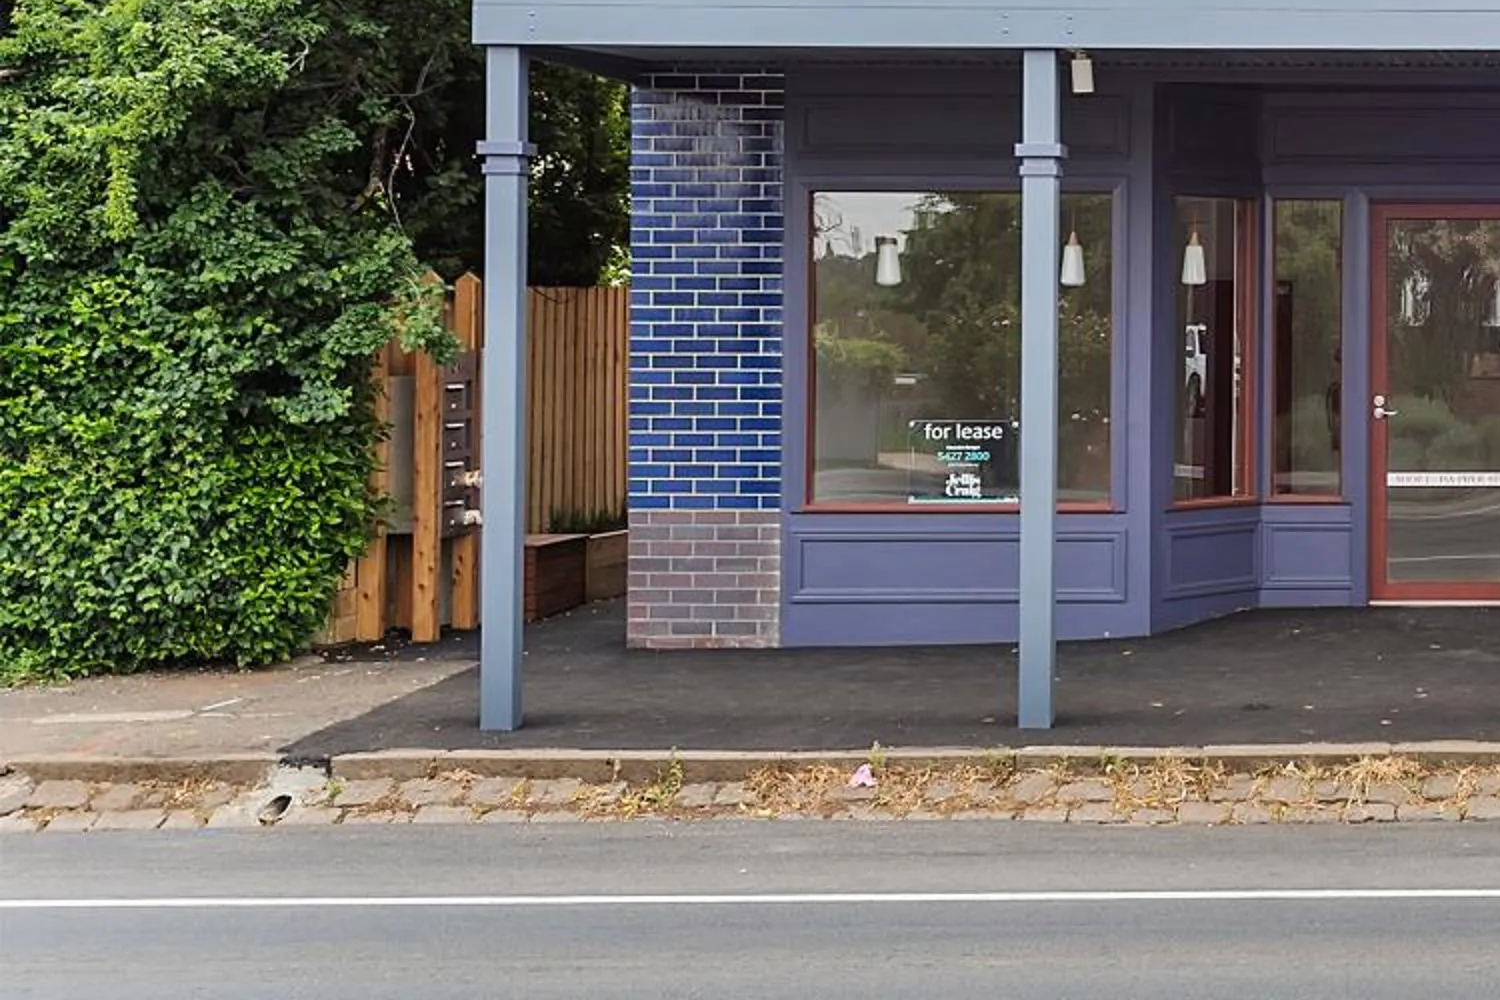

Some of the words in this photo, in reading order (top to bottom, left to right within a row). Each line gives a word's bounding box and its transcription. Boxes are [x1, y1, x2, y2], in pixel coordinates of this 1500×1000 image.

[923, 423, 953, 440] for
[955, 423, 1003, 440] lease
[937, 451, 963, 461] 5427
